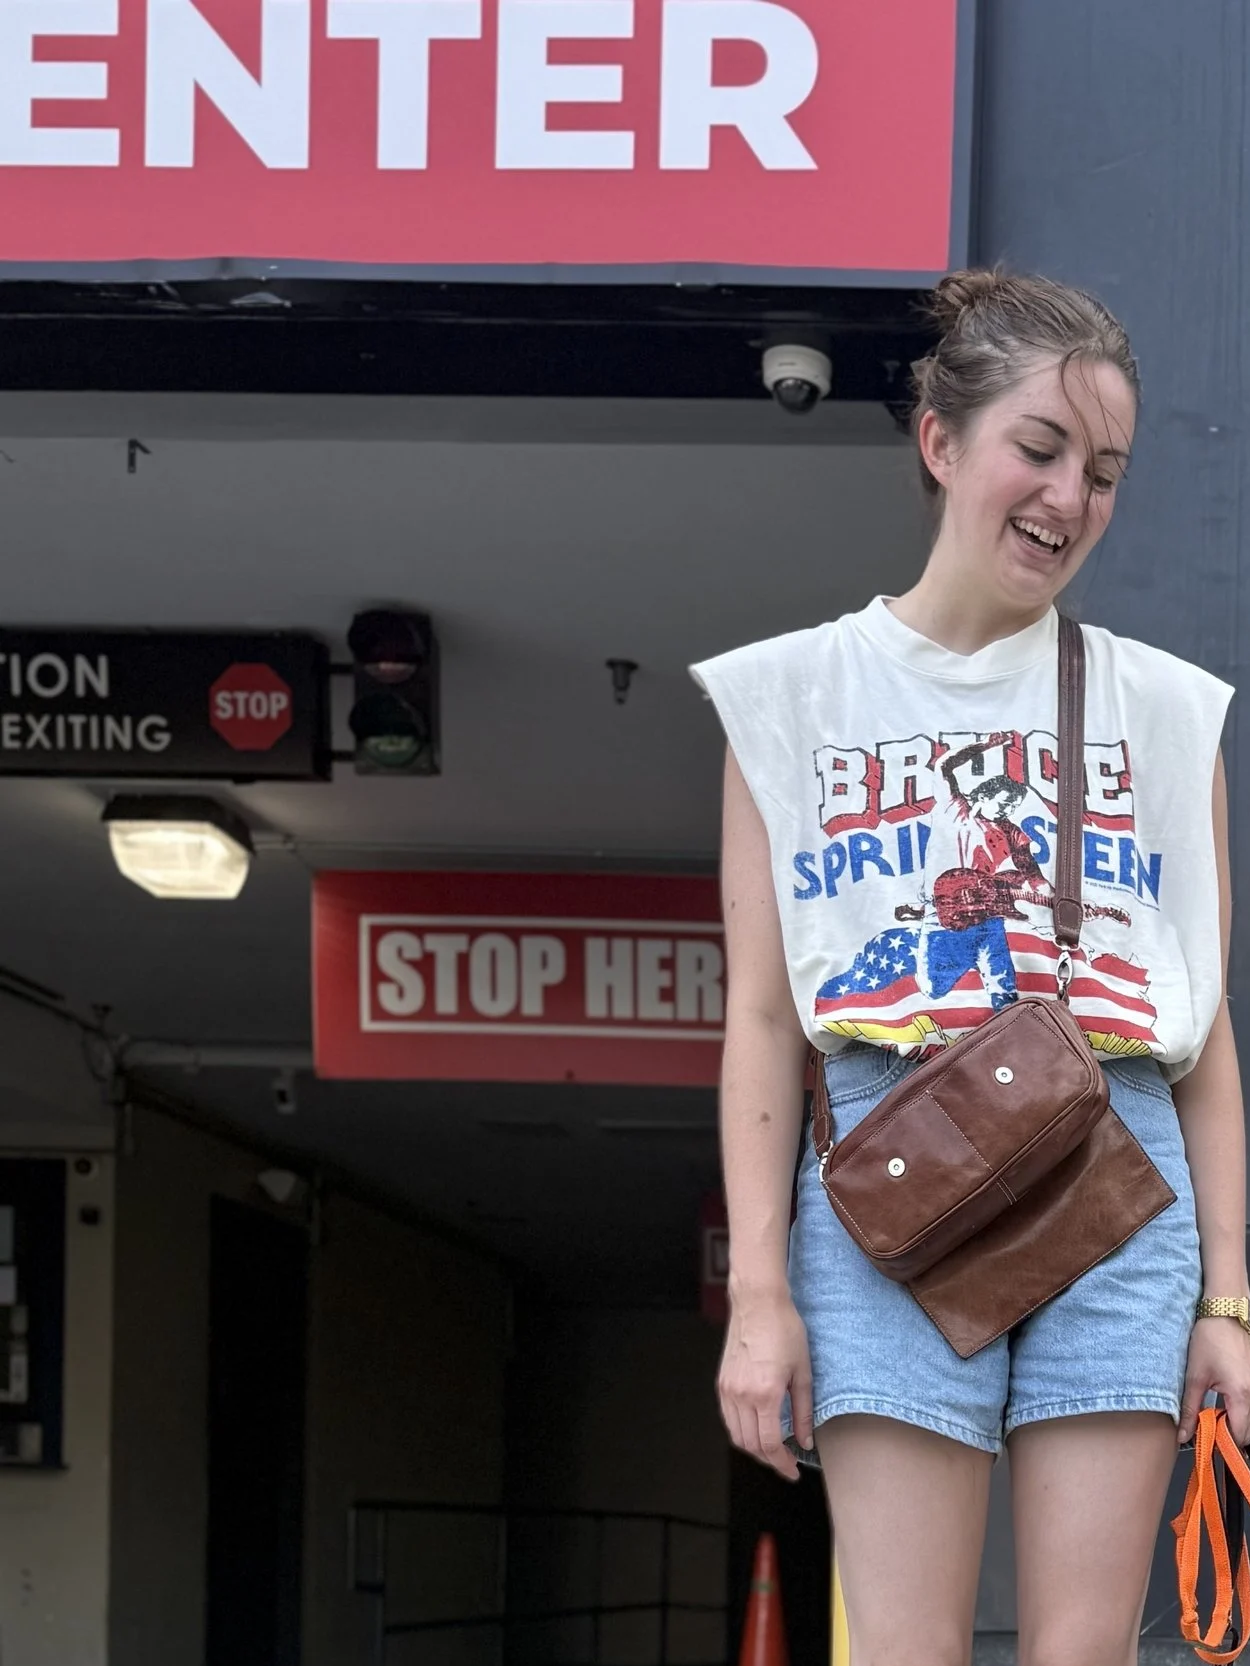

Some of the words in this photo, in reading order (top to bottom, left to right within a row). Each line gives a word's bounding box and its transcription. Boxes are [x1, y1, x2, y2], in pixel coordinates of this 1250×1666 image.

[0, 0, 818, 170] ENTER
[0, 652, 108, 698] ION
[214, 690, 289, 720] STOP
[2, 713, 172, 752] EXITING
[376, 931, 567, 1018] STOP
